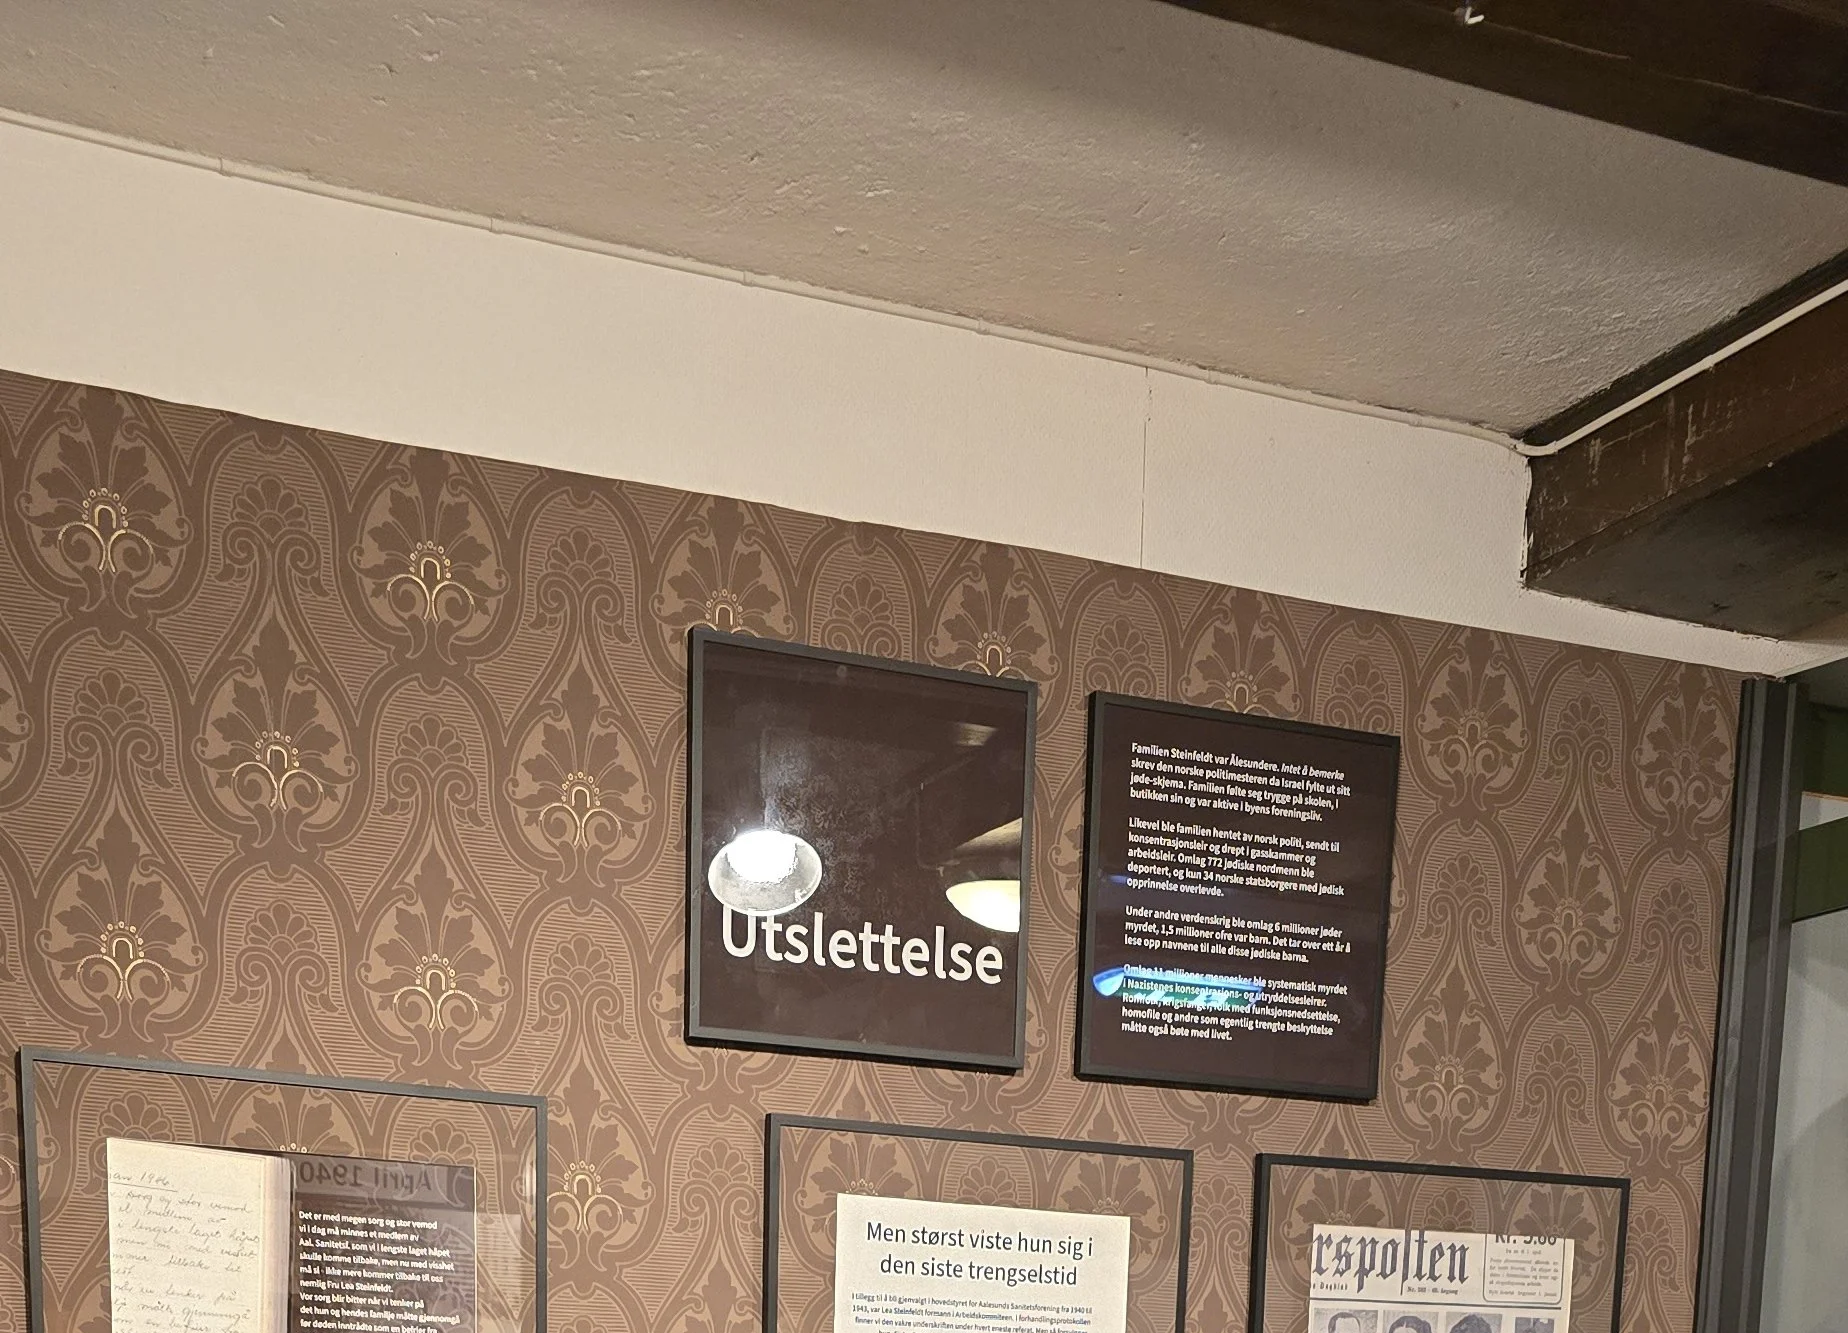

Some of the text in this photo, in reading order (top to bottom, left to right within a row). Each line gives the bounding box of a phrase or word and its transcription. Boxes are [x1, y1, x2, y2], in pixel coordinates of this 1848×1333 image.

[1131, 742, 1169, 757] Familien
[1170, 748, 1213, 763] Steinfeldt
[1214, 755, 1229, 765] var
[1229, 753, 1279, 772] Ålesundere.
[1280, 763, 1301, 775] Intet
[1308, 766, 1345, 781] bemerke
[1131, 757, 1155, 770] skrev
[1156, 760, 1173, 772] den
[1174, 765, 1204, 777] norske
[1205, 768, 1268, 785] politimesteren
[1281, 777, 1305, 790] Israel
[1305, 780, 1325, 793] fylte
[1336, 784, 1351, 797] sitt
[1129, 771, 1186, 789] jøde-skjema.
[1188, 780, 1225, 794] Familien
[1226, 784, 1247, 797] følte
[1247, 789, 1263, 802] seg
[1263, 790, 1291, 805] trygge
[1304, 795, 1334, 810] skolen,
[1130, 786, 1169, 802] butikken
[1169, 792, 1183, 804] sin
[1196, 798, 1212, 807] var
[1212, 798, 1239, 811] aktive
[1244, 801, 1270, 815] byens
[1271, 805, 1323, 822] foreningsliv.
[1128, 817, 1160, 831] Likevel
[1161, 820, 1175, 833] ble
[1176, 822, 1212, 837] familien
[1212, 826, 1241, 841] hentet
[1254, 834, 1278, 845] norsk
[1279, 836, 1304, 850] politi,
[1305, 840, 1330, 851] sendt
[1330, 841, 1340, 853] til
[1128, 831, 1208, 851] konsentrasjonsleir
[1221, 843, 1245, 857] drept
[1250, 848, 1304, 862] gasskammer
[1127, 847, 1315, 878] arbeidsleir. Omlag 772 jødiske nordmenn ble
[1127, 861, 1171, 878] deportert,
[1185, 867, 1202, 880] kun
[1215, 873, 1244, 885] norske
[1245, 876, 1298, 892] statsborgere
[1298, 882, 1318, 893] med
[1317, 883, 1344, 896] jødisk
[1126, 877, 1224, 897] opprinnelse overlevde.
[722, 905, 1003, 985] Utslettelse
[1267, 979, 1348, 996] systematisk myrdet
[1121, 1020, 1233, 1041] måtte også bøte med livet.
[867, 1222, 1093, 1261] Men størst viste hun sig i
[880, 1253, 1077, 1287] den siste trengselstid
[881, 1306, 893, 1314] Lea
